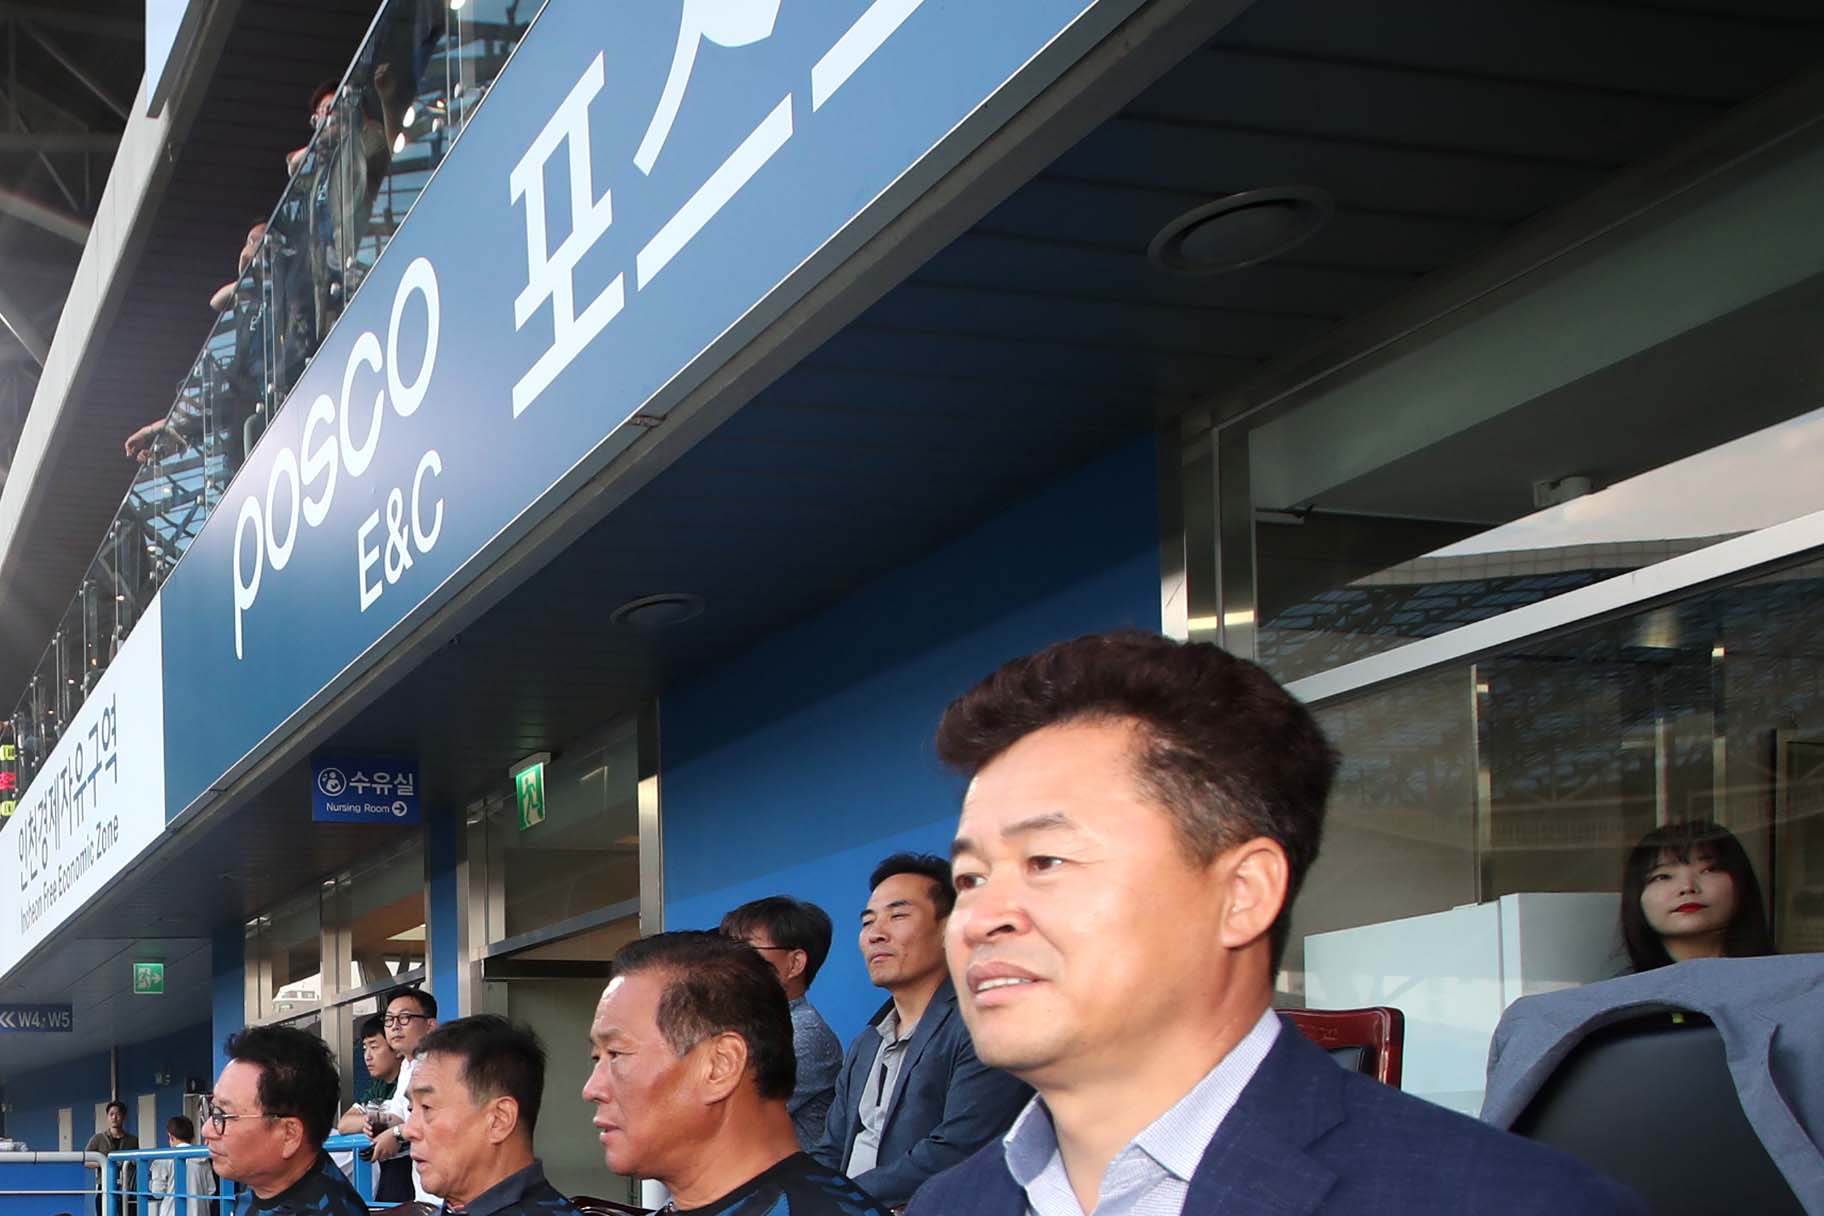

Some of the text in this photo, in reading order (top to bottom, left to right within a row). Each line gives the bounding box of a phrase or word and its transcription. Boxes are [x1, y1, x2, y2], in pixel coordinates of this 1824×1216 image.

[358, 450, 444, 613] E&C
[18, 692, 118, 891] 인천경제자유구역
[326, 802, 390, 814] Nursing Room
[349, 771, 415, 796] 수유실
[43, 880, 57, 918] Free
[58, 838, 93, 896] Economic
[96, 814, 119, 861] Zone
